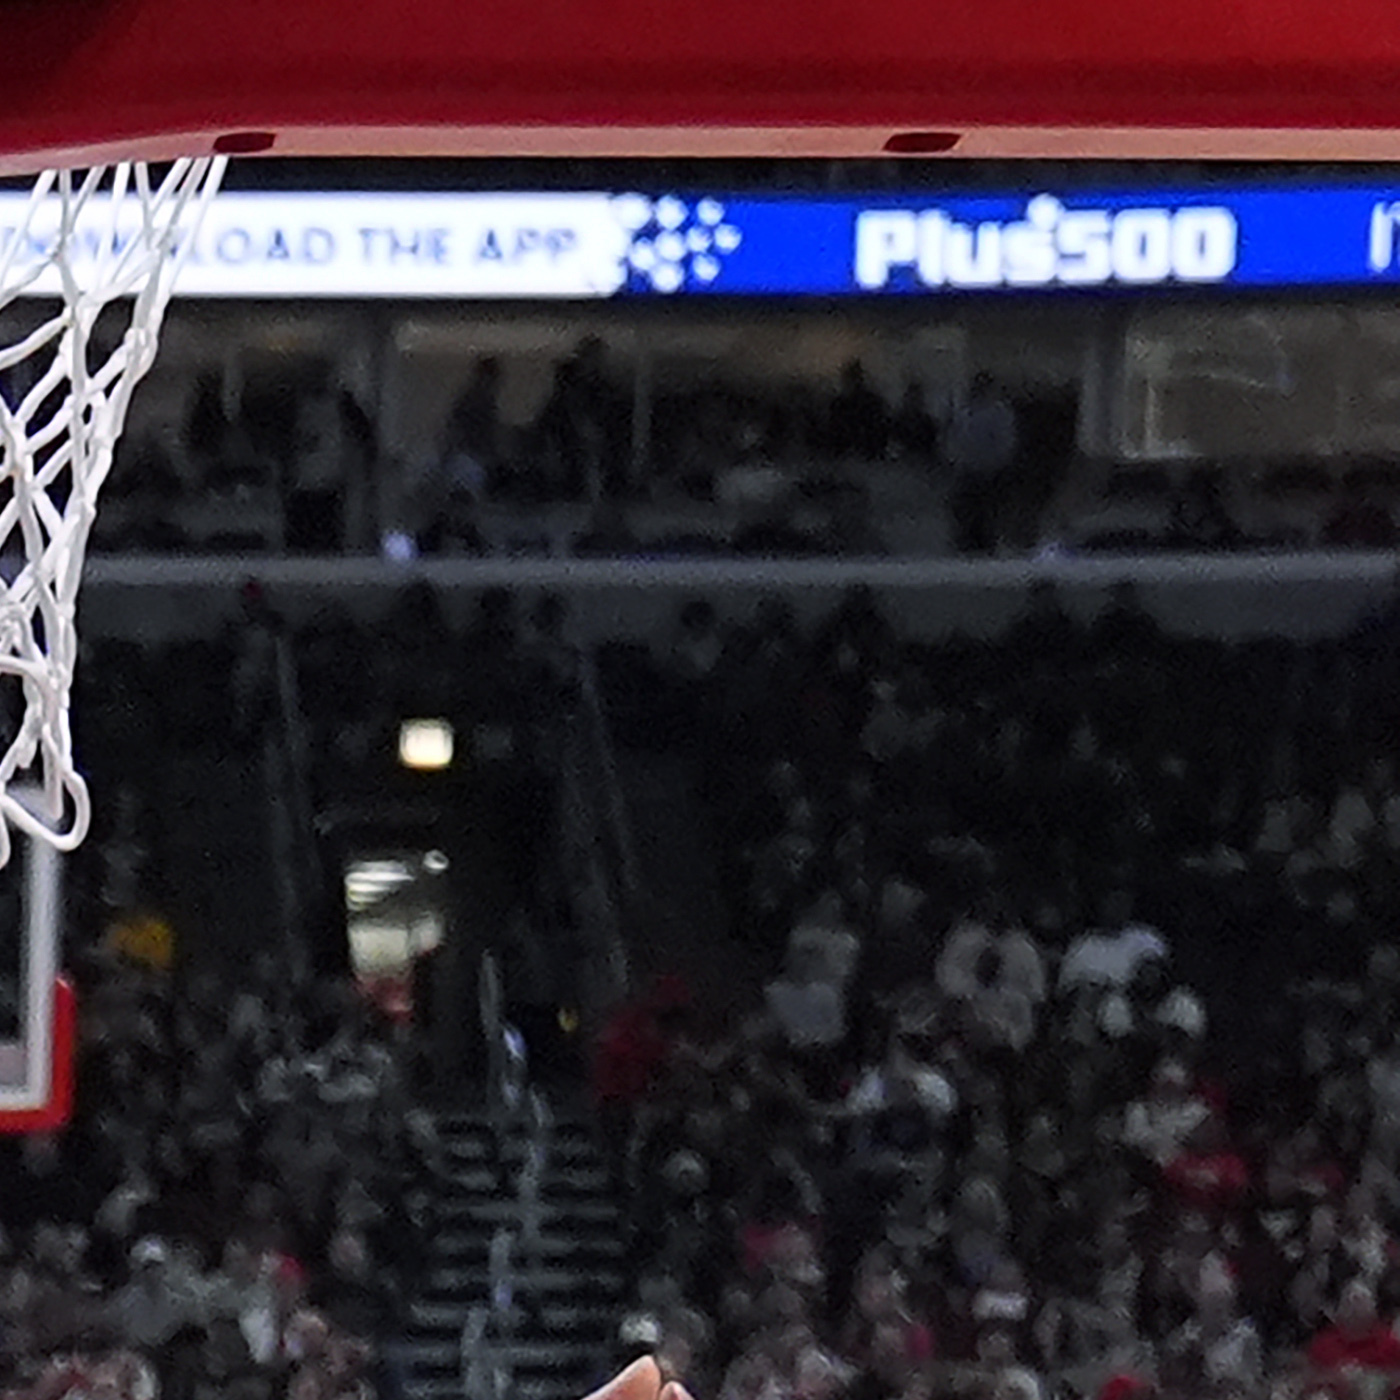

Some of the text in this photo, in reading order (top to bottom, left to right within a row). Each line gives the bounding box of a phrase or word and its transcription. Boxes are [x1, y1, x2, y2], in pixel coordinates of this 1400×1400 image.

[357, 226, 453, 266] THE
[478, 226, 579, 266] APP
[855, 194, 1239, 289] Plus500
